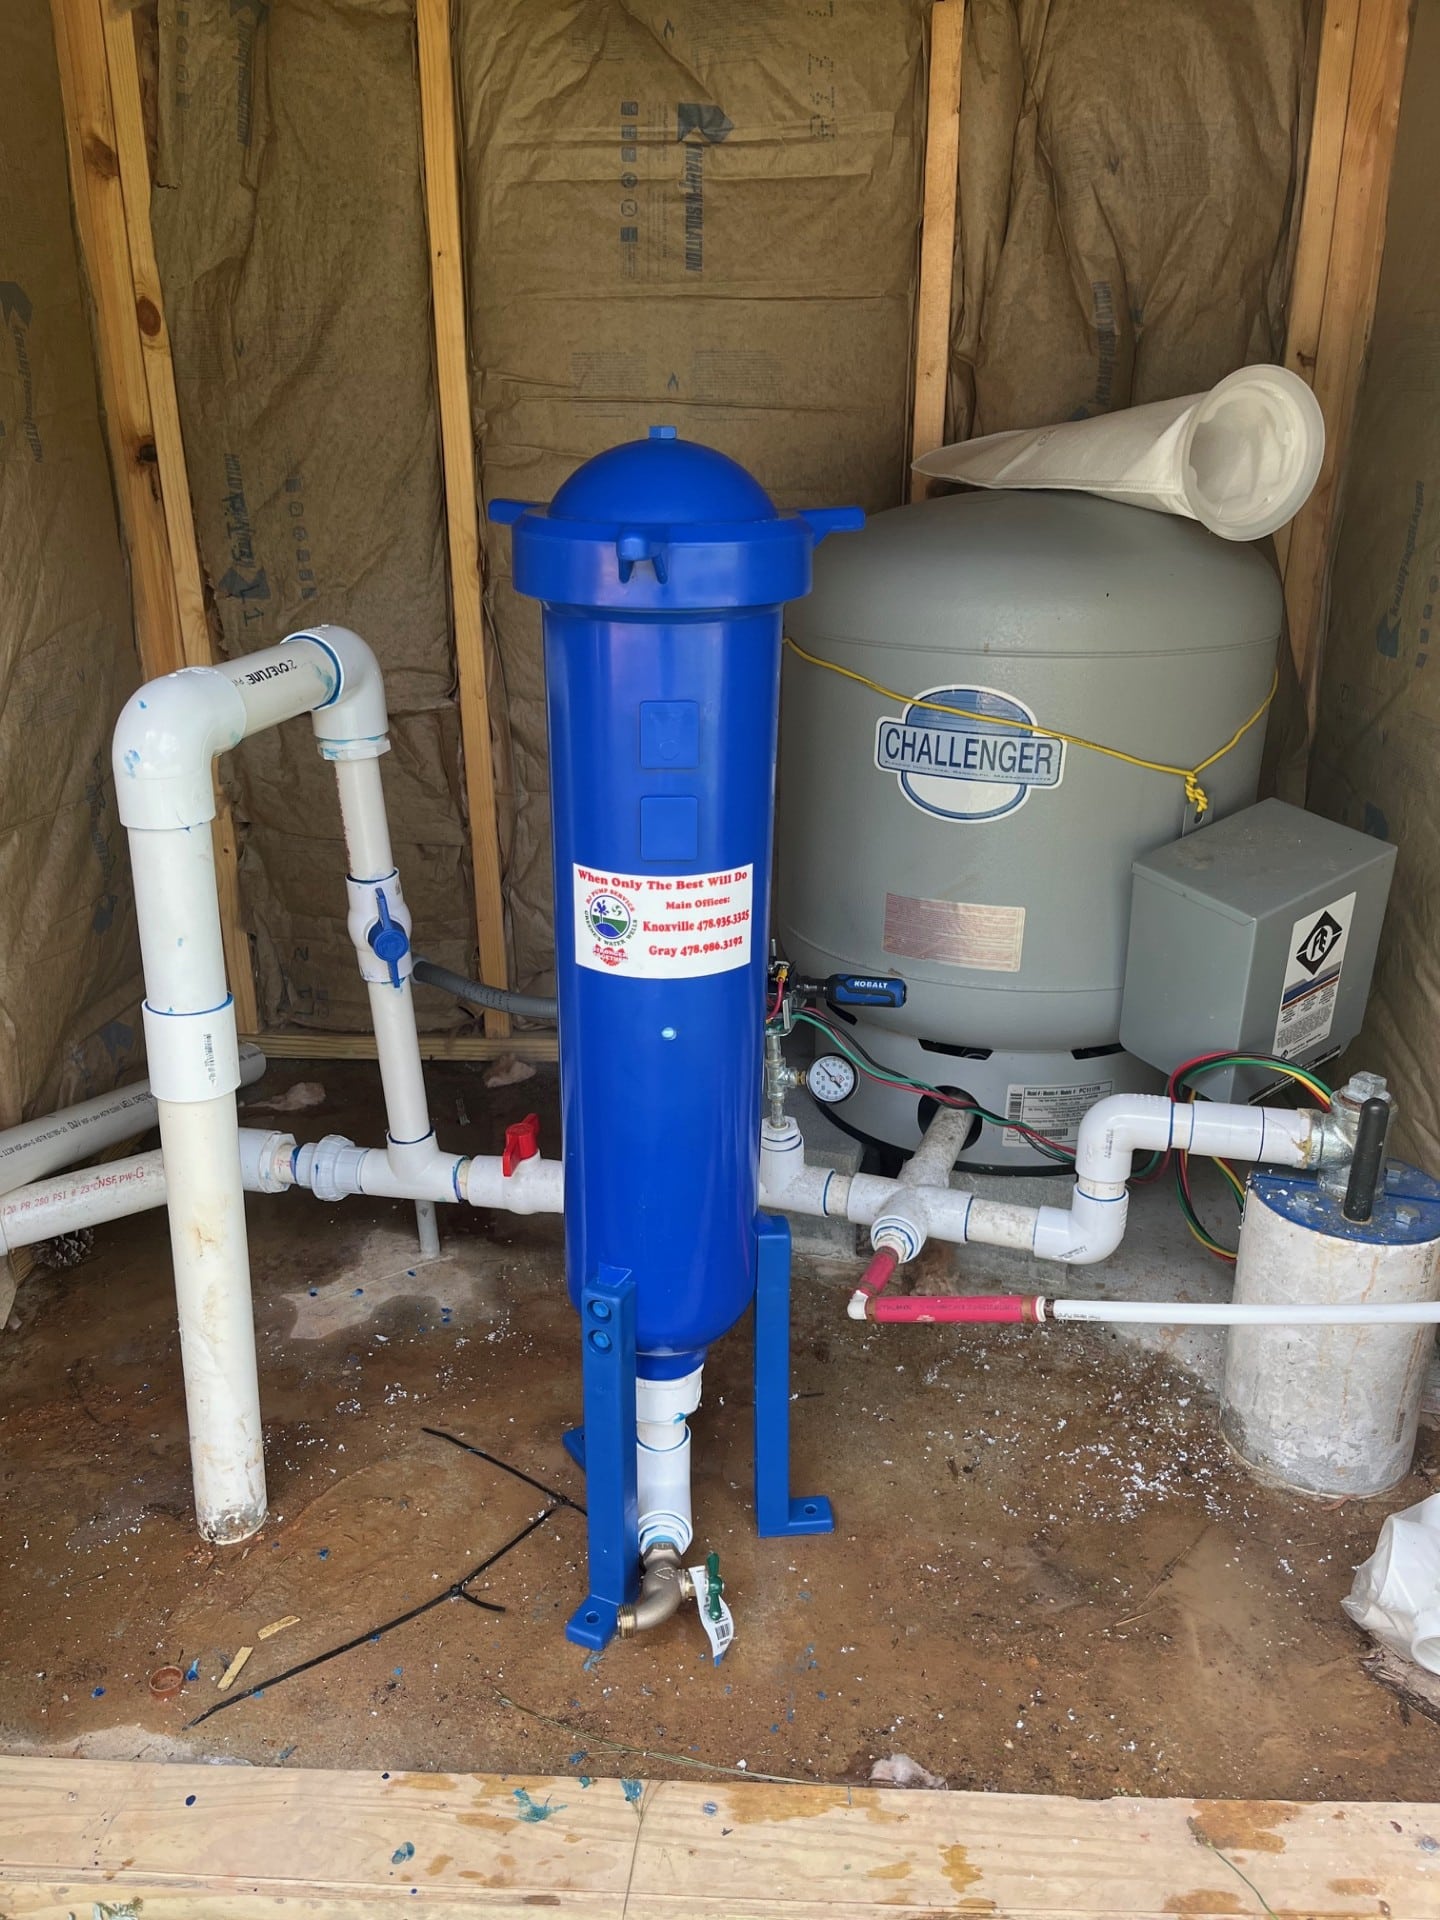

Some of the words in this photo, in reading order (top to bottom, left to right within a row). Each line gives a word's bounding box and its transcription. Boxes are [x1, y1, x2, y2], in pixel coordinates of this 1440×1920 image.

[885, 727, 1053, 775] CHALLENGER
[578, 868, 608, 886] When
[611, 877, 642, 892] Only
[647, 880, 673, 890] The
[676, 877, 704, 890] Best
[707, 874, 732, 887] Will
[733, 871, 748, 883] Do
[609, 889, 636, 913] SERVICE
[665, 900, 692, 911] Main
[694, 896, 731, 909] Offices:
[604, 939, 627, 948] WATER
[625, 918, 639, 940] WELLS
[643, 918, 695, 933] Knoxville
[648, 944, 678, 958] Gray
[680, 935, 743, 957] 478.986.3192
[854, 980, 888, 989] KOBALT
[20, 1199, 31, 1211] PR
[52, 1190, 67, 1202] PSI
